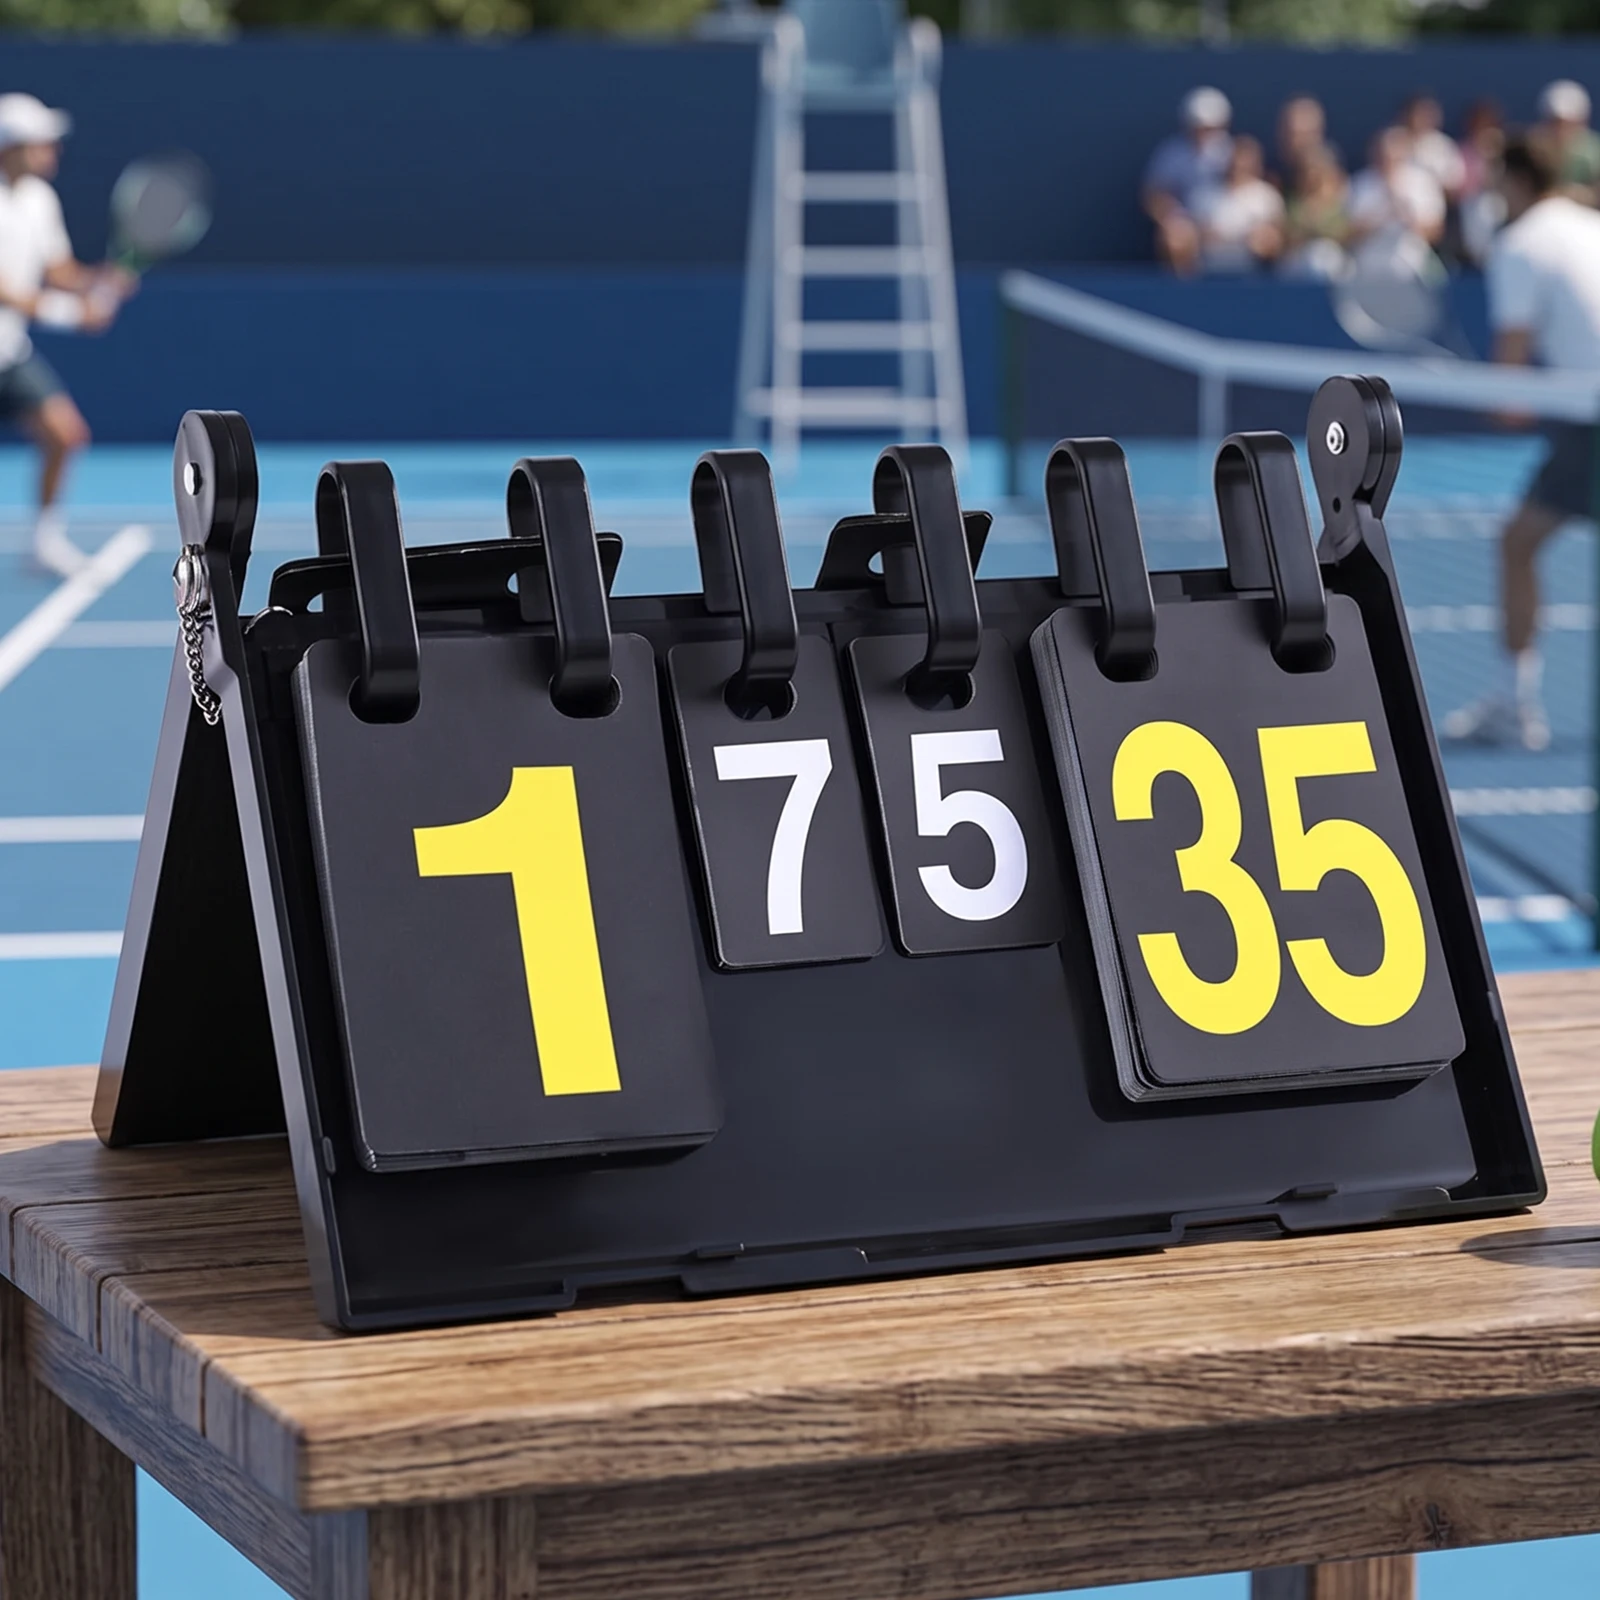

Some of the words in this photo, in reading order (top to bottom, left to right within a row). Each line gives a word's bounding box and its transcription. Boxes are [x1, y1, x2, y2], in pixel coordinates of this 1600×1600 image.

[413, 765, 622, 1096] 1
[713, 738, 833, 936] 7
[910, 729, 1028, 921] 5
[1112, 720, 1427, 1036] 35
